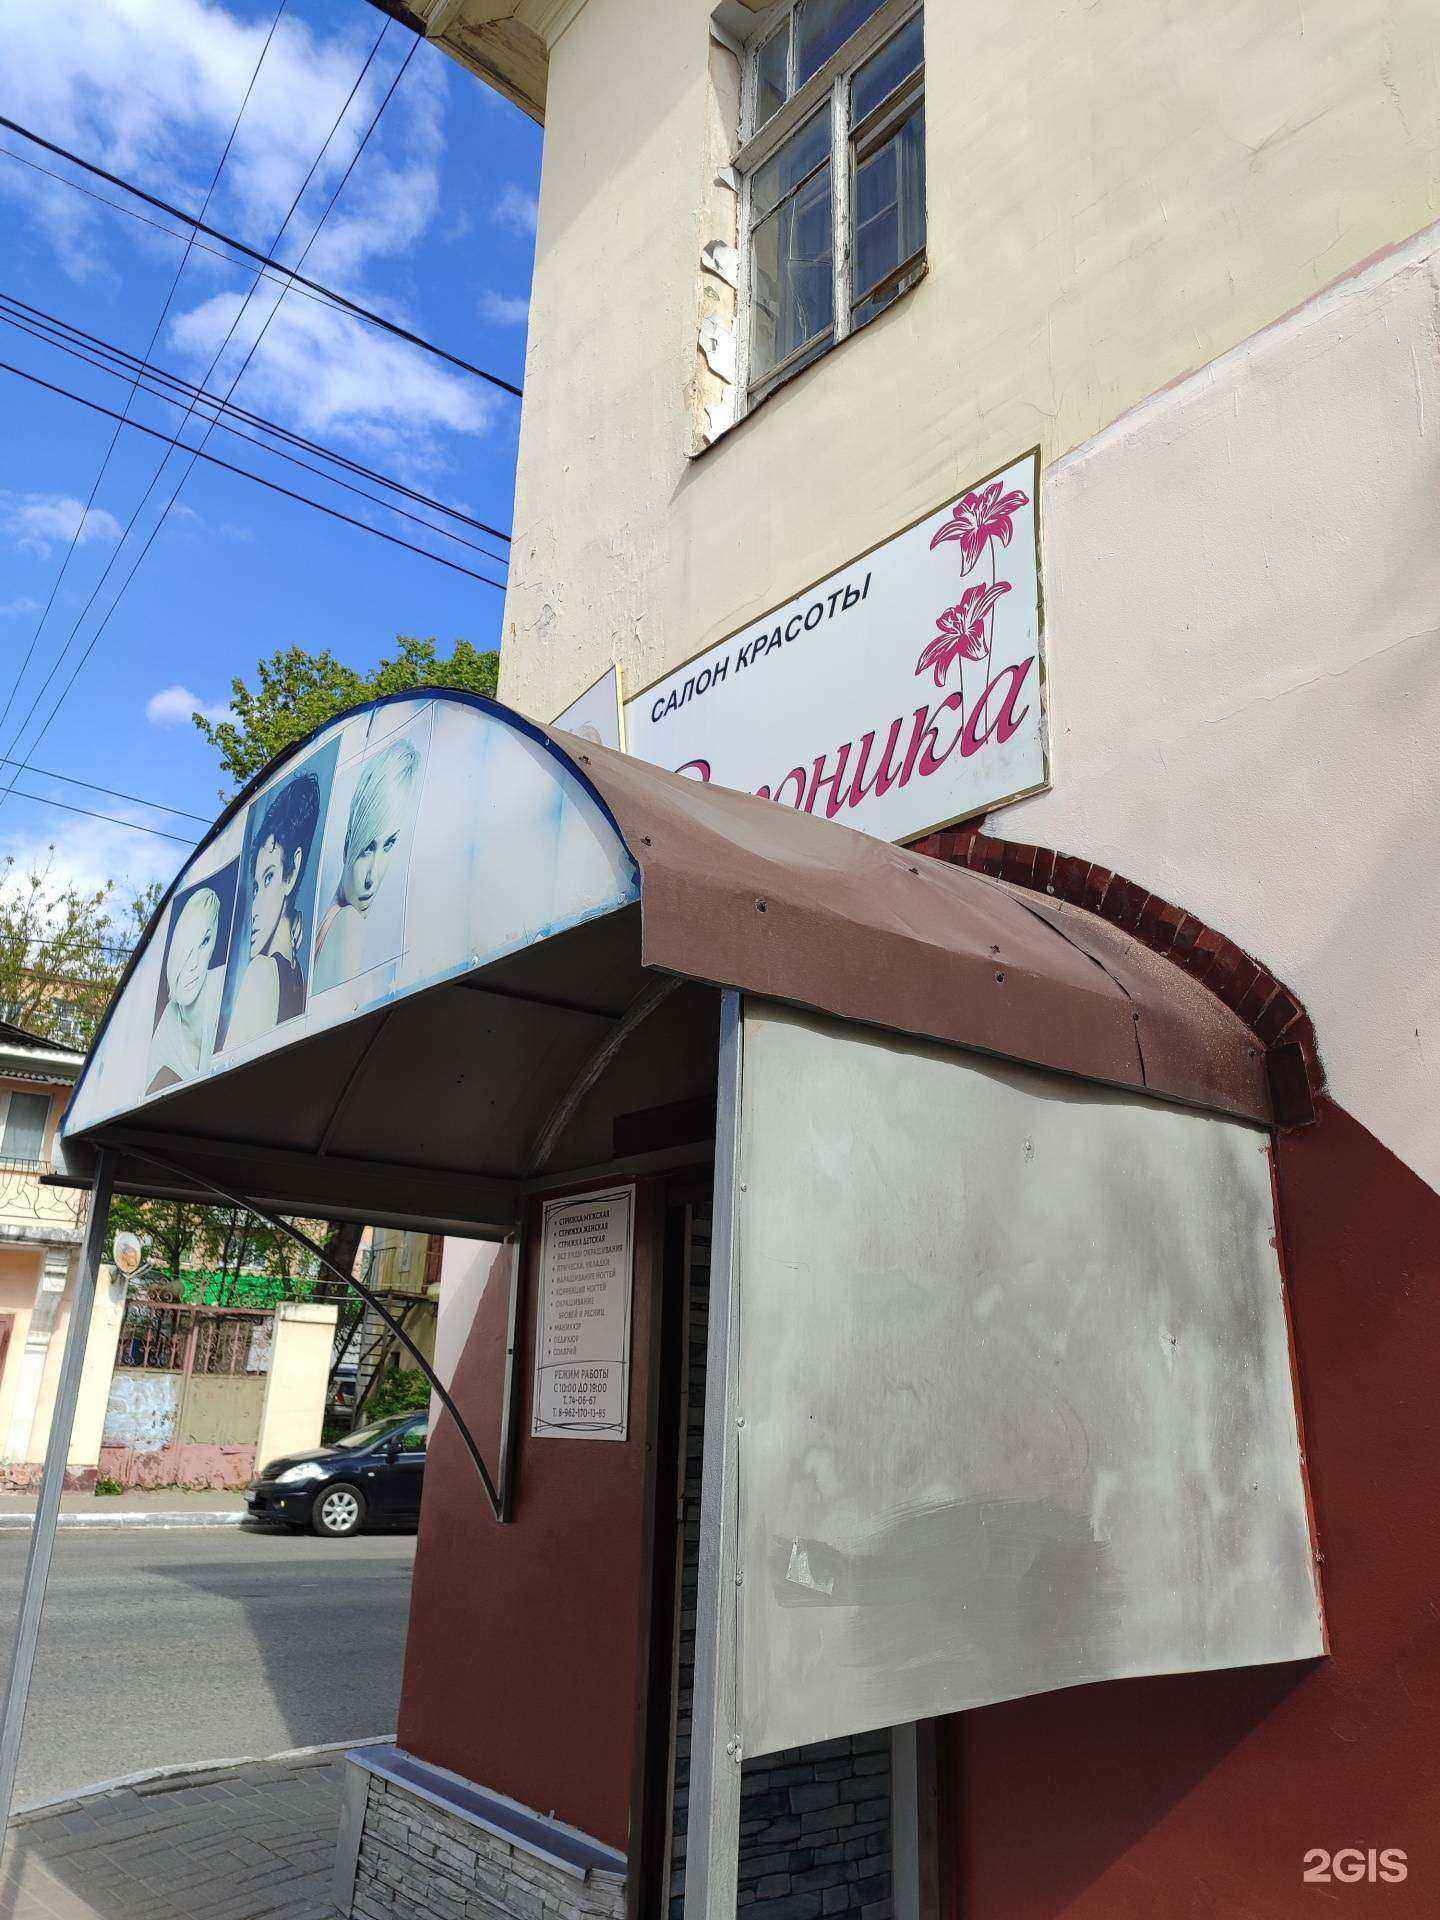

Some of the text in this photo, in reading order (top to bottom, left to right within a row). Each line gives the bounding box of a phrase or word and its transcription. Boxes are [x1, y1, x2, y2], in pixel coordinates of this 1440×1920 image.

[651, 572, 872, 723] САЛОН КРАСОТЫ
[674, 655, 1035, 819] оника
[553, 1383, 558, 1393] С
[578, 1382, 588, 1393] ДО
[554, 1368, 609, 1380] РЕЖИМ РАБОТЫ
